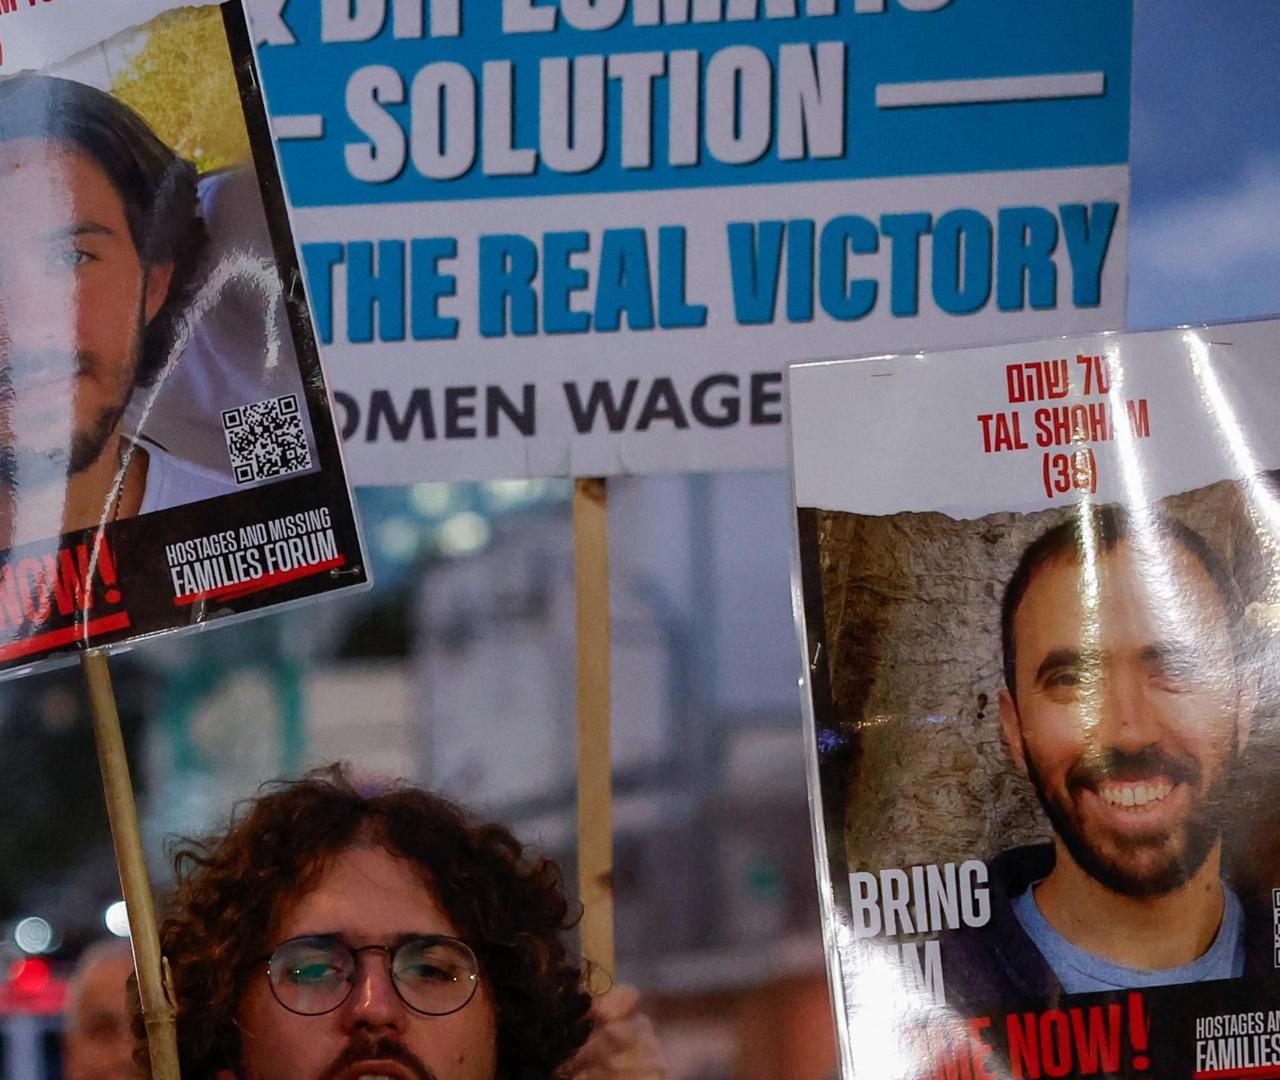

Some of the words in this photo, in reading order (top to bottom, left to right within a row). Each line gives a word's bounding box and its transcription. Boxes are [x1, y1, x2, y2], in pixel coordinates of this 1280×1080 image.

[344, 43, 844, 184] SOLUTION
[301, 237, 458, 345] THE
[478, 225, 708, 337] REAL
[728, 201, 1118, 328] VICTORY
[333, 384, 536, 443] OMEN
[563, 372, 782, 434] WAGE
[1006, 359, 1070, 403] שהם
[977, 411, 1028, 453] TAL
[1034, 399, 1150, 447] SHOHM
[1042, 448, 1097, 498] (38)
[166, 530, 238, 567] HOSTAGES
[239, 524, 269, 551] AND
[267, 507, 332, 543] MISSING
[170, 549, 263, 599] FAMILIES
[265, 529, 339, 577] FORUM
[849, 859, 991, 939] BRING
[1196, 1011, 1264, 1040] HOSTAGES
[1196, 1033, 1280, 1073] FAMILIES
